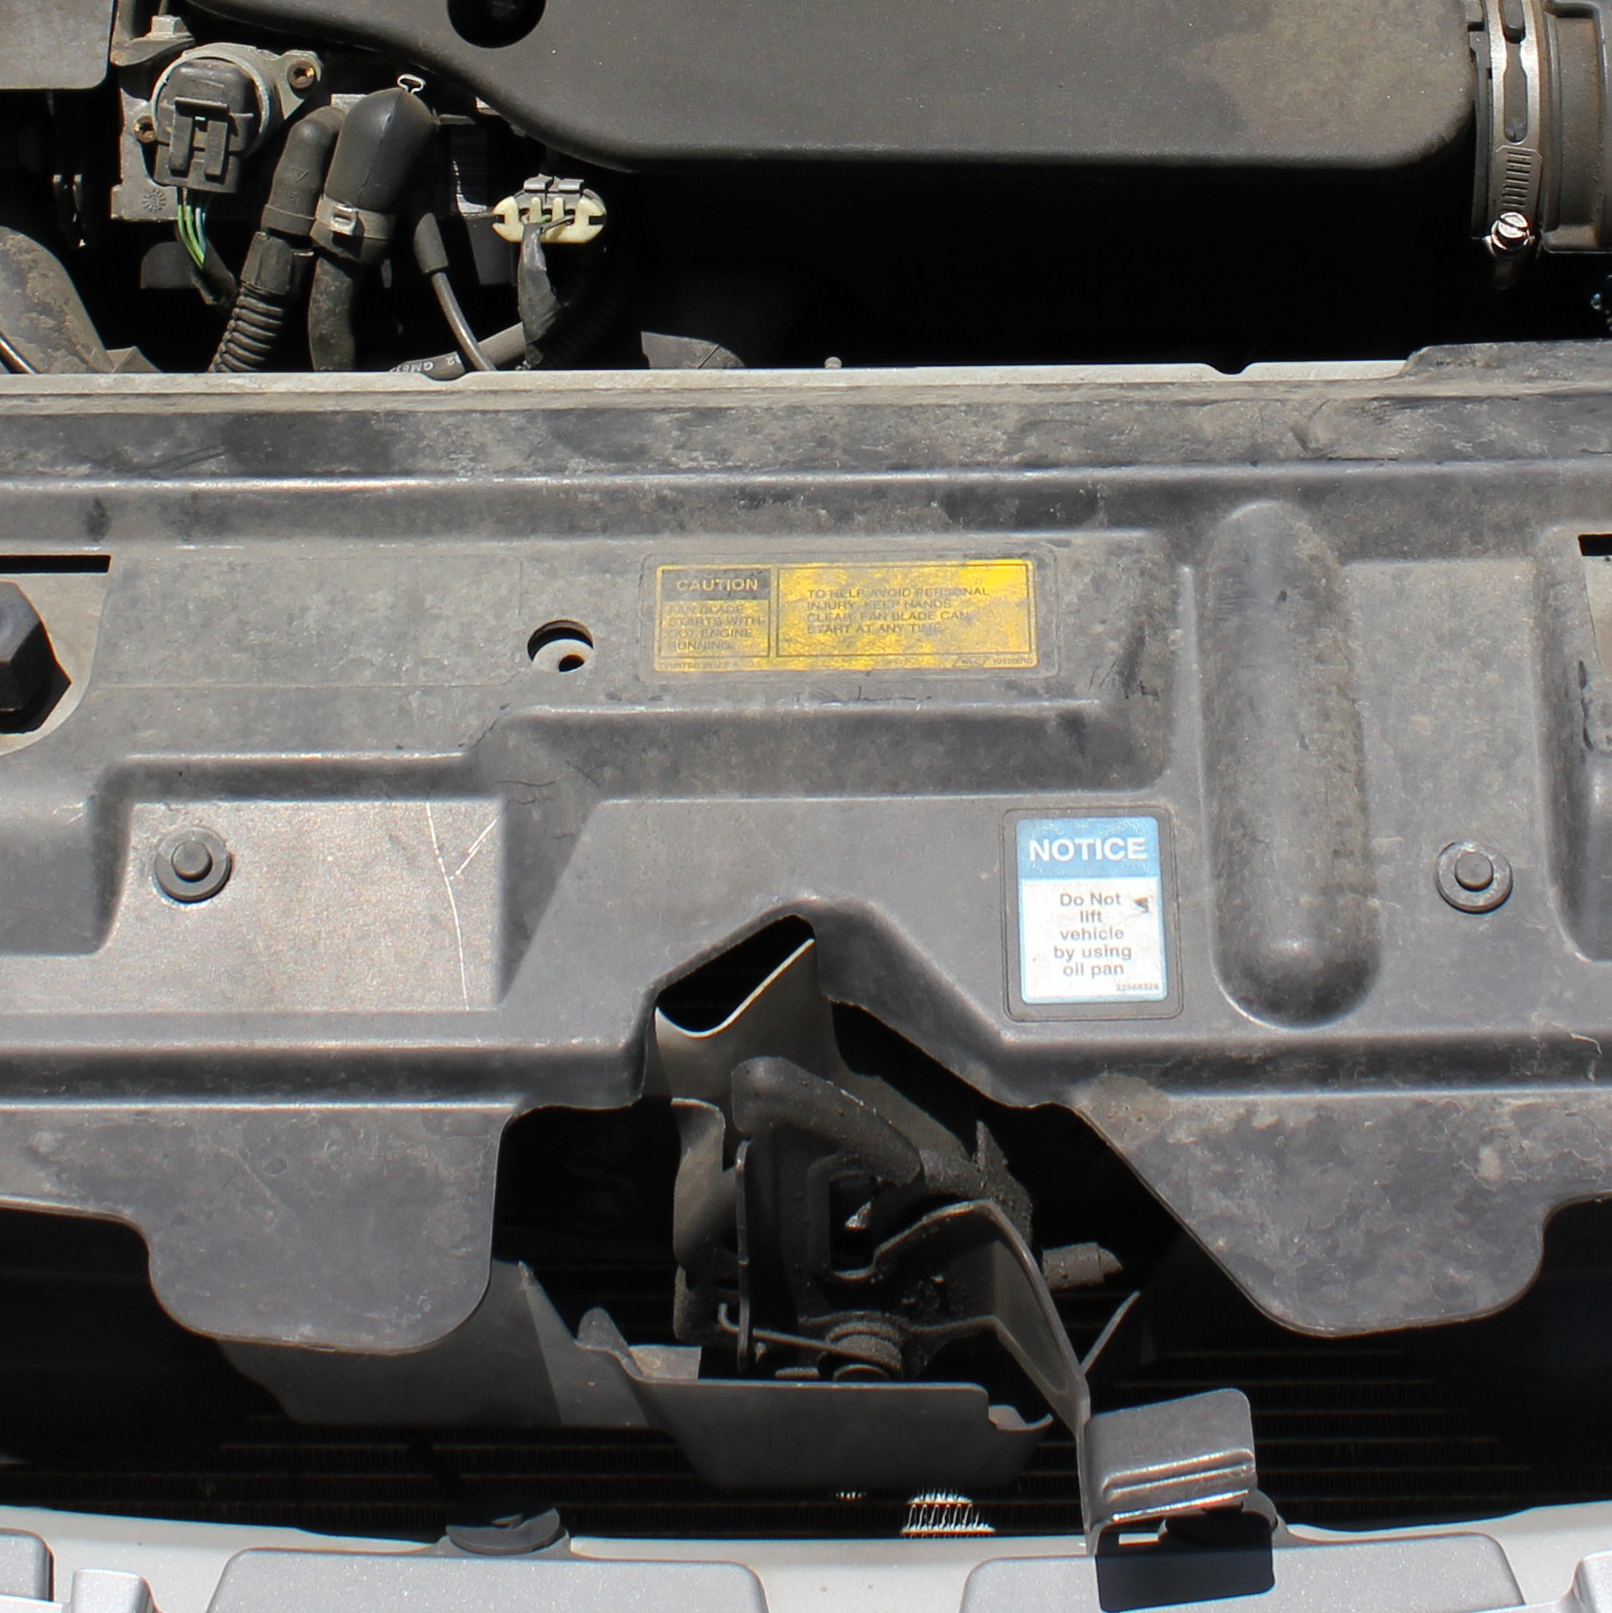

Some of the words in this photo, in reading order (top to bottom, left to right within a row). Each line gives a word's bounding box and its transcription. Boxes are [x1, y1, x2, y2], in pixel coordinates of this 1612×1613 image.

[676, 578, 758, 591] CAUTION
[808, 589, 826, 599] TO
[904, 599, 952, 609] HANDS
[892, 611, 936, 621] BLADE
[807, 625, 851, 634] START
[856, 625, 874, 633] AT
[878, 624, 905, 633] ANY
[1029, 837, 1147, 862] NOTICE
[1060, 893, 1084, 907] Do
[1090, 892, 1121, 906] Not
[1079, 910, 1103, 923] lift
[1060, 926, 1125, 941] vehicle
[1054, 945, 1074, 962] by
[1082, 944, 1132, 960] using
[1063, 963, 1085, 976] oil
[1091, 963, 1124, 979] pan
